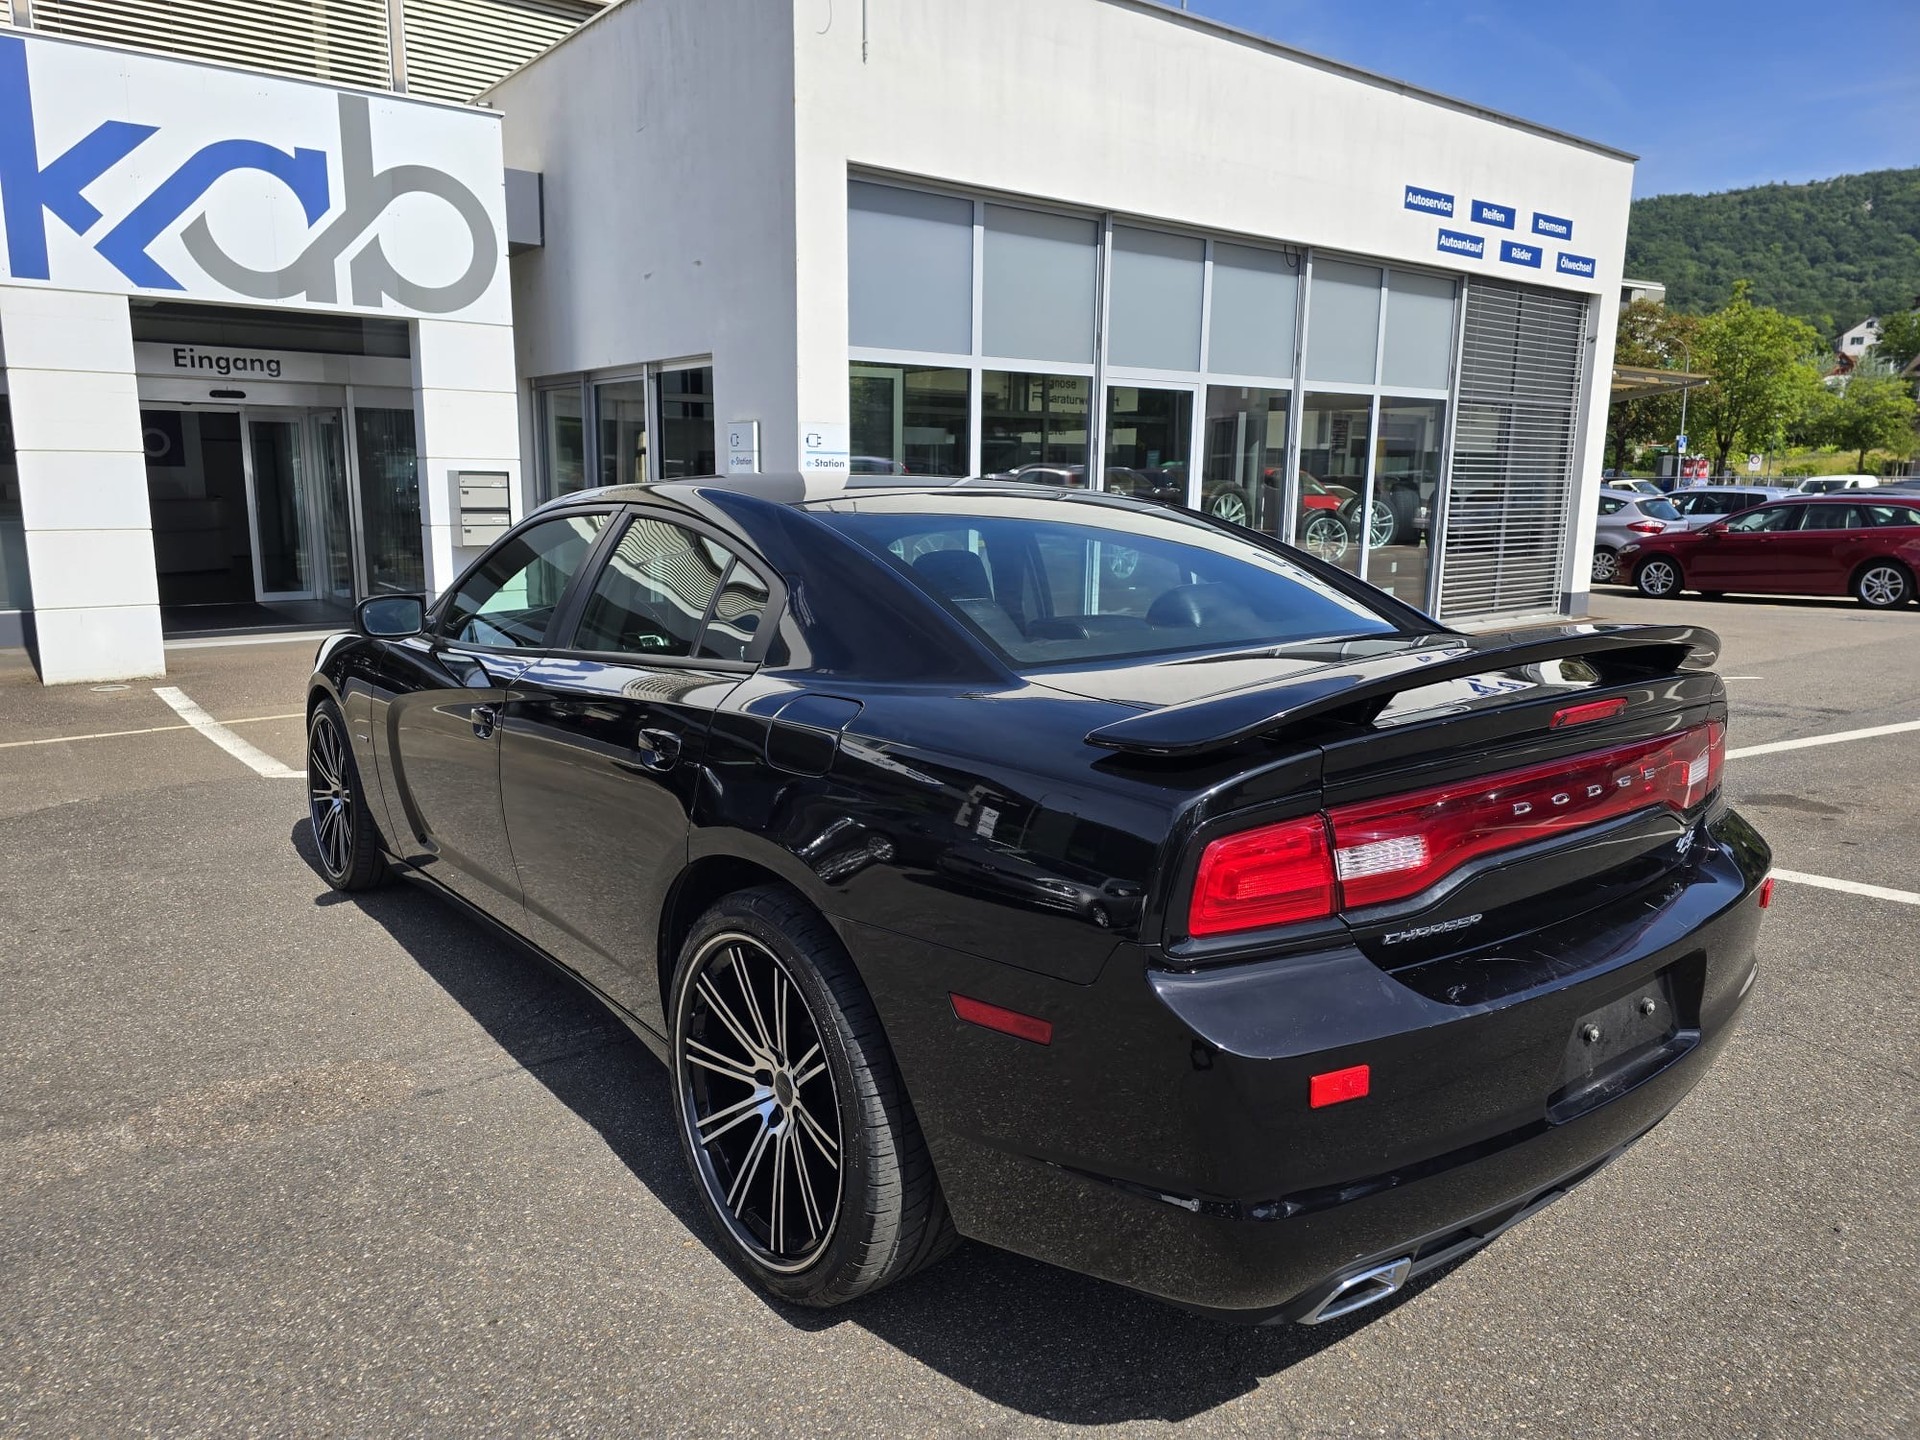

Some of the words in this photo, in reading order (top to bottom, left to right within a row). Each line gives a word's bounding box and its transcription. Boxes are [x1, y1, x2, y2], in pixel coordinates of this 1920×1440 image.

[0, 36, 498, 313] kab
[1407, 192, 1452, 212] Autoservice
[1482, 208, 1505, 223] Reifen
[1538, 219, 1567, 235] Bremsen
[1439, 235, 1483, 253] Autoankauf
[1511, 247, 1532, 261] Räder
[1560, 257, 1592, 273] Ölwechsel
[173, 347, 281, 378] Eingang
[806, 458, 845, 468] e-Station
[1513, 767, 1656, 815] DODGE
